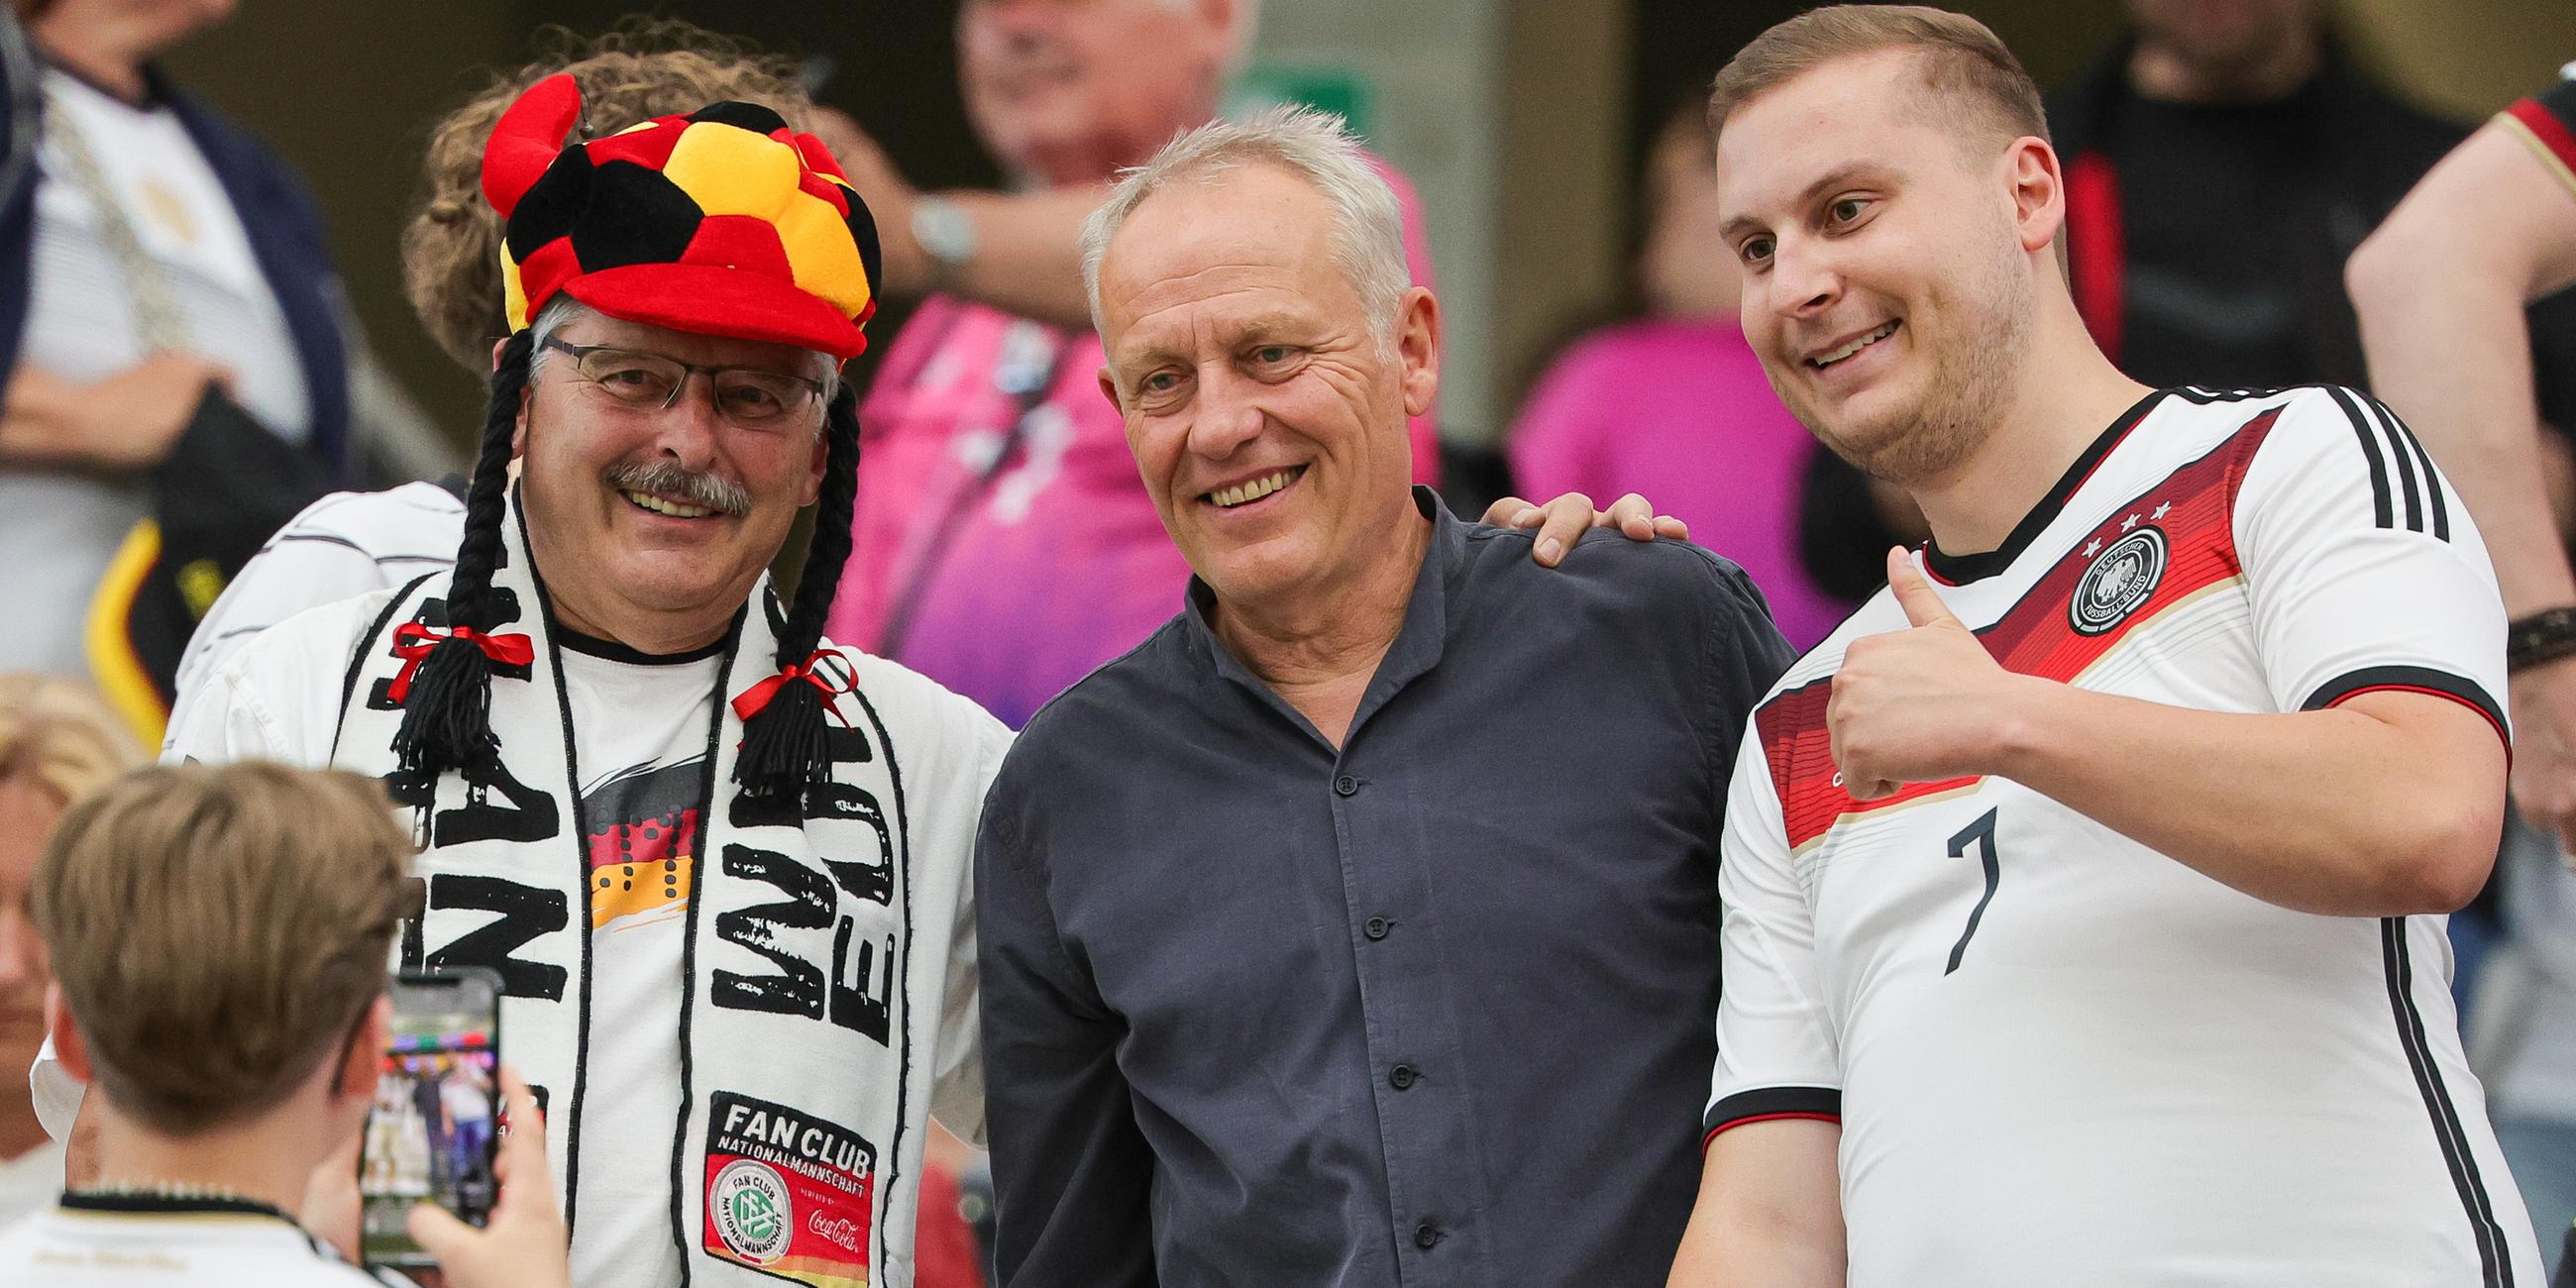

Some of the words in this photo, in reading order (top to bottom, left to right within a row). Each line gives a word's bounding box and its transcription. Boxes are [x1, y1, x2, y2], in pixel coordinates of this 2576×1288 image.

[2095, 542, 2145, 576] DEUTSCHER
[1944, 805, 1999, 976] 7
[717, 1135, 865, 1198] NATIONALMANNSCHAFT
[723, 1104, 799, 1148] FAN
[801, 1127, 870, 1180] CLUB
[733, 1175, 751, 1190] FAN
[753, 1177, 776, 1200] CLUB
[722, 1196, 783, 1254] NATIONALMANNSCHAFT
